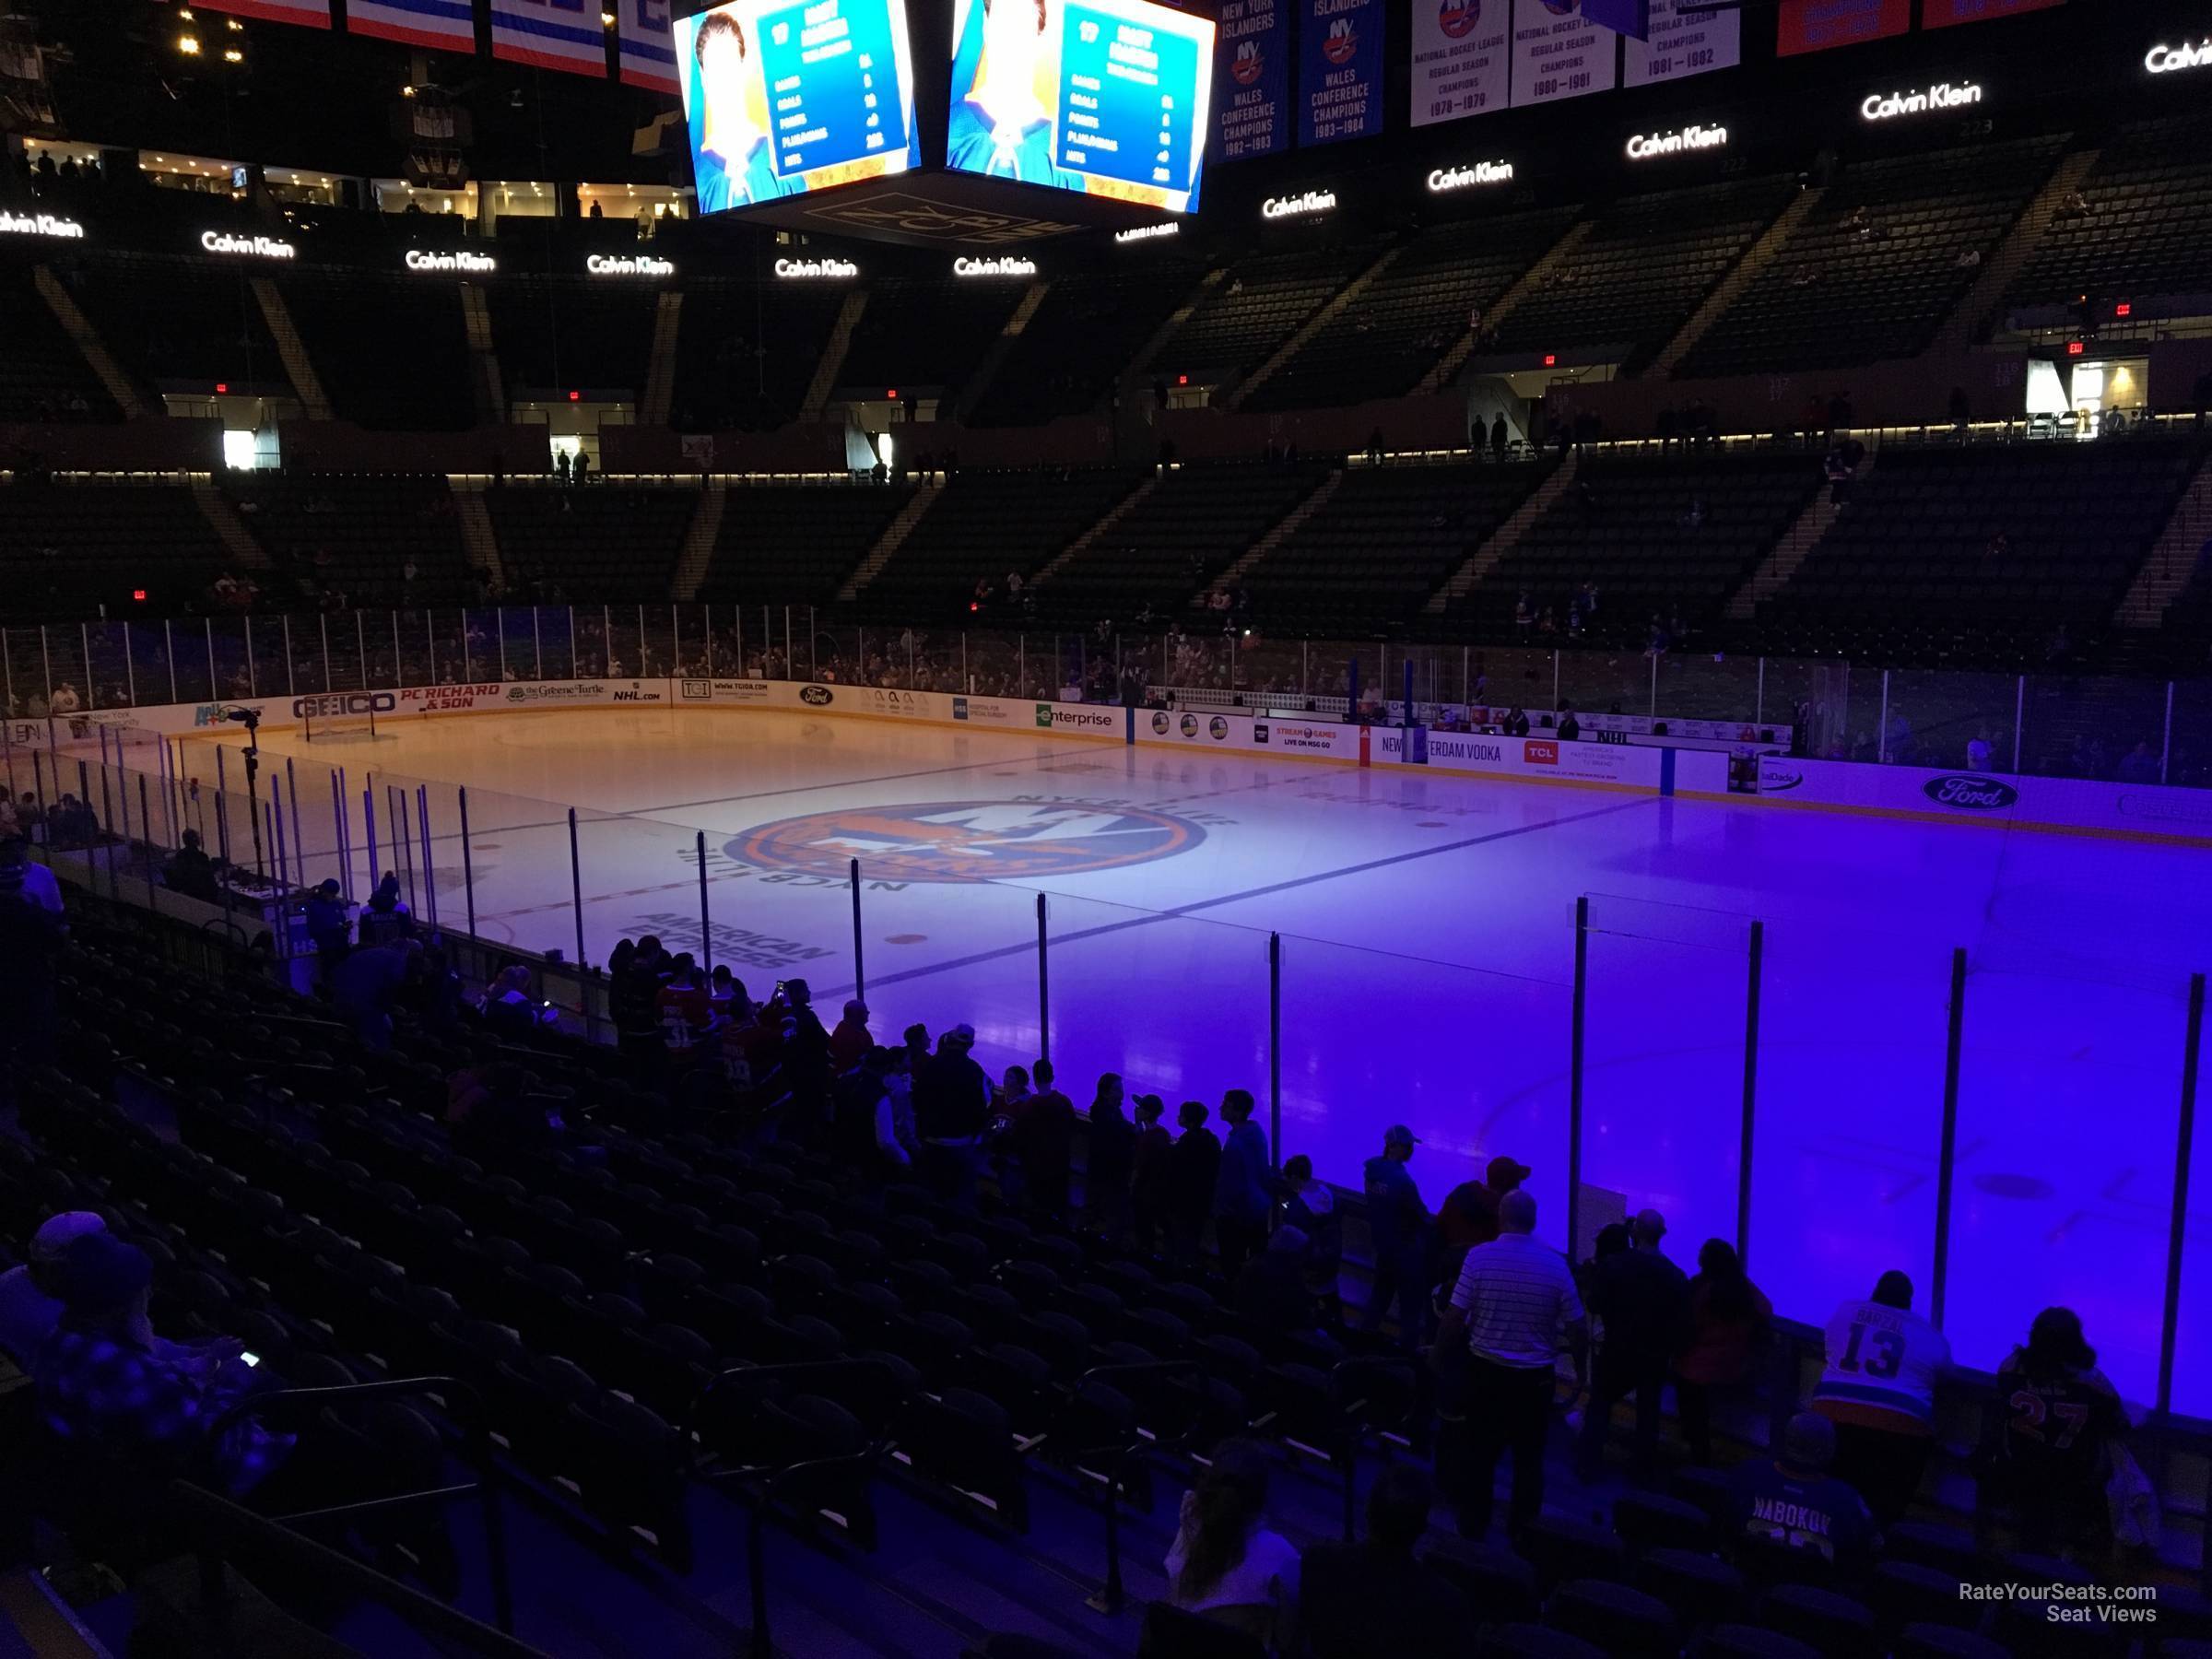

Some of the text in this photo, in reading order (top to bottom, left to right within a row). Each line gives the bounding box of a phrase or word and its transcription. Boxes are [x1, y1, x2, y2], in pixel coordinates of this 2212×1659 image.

[1222, 1, 1242, 20] NEW
[1222, 13, 1275, 39] ISLANDERS
[1516, 26, 1549, 41] NATIONAL
[1552, 18, 1581, 34] HOCKEY
[1415, 34, 1504, 64] NATIONAL HOCKEY LEAGUE
[1531, 35, 1594, 57] REGULAR SEASON
[1657, 31, 1705, 52] CHAMPIONS
[1429, 57, 1489, 79] REGULAR SEASON
[1541, 56, 1583, 73] CHAMPIONS
[1325, 68, 1356, 88] WALES
[1439, 77, 1479, 95] CHAMPIONS
[1234, 89, 1262, 106] WALES
[1312, 82, 1370, 107] CONFERENCE
[1862, 80, 1981, 119] Calvin Klein
[1221, 101, 1276, 125] CONFERENCE
[1313, 100, 1367, 123] CHAMPIONS
[1224, 119, 1273, 140] CHAMPIONS
[1628, 123, 1726, 158] Calvin Klein
[1429, 159, 1512, 190] Calvin Klein
[1263, 190, 1335, 218] Calvin Klein
[0, 211, 83, 238] alvin Klein
[202, 231, 294, 258] Calvin Klein
[406, 250, 495, 270] Calvin Klein
[587, 254, 673, 275] Calvin Klein
[775, 258, 857, 276] Calvin Klein
[954, 256, 1036, 275] Calvin Klein
[2069, 342, 2083, 354] EXIT
[425, 685, 500, 699] RICHARD
[539, 685, 574, 696] Greene
[575, 684, 605, 693] Turtle
[806, 688, 828, 703] Ford
[293, 693, 395, 718] GEICO
[427, 698, 474, 710] & SON
[1041, 711, 1112, 726] enterprise
[1277, 727, 1303, 736] STREAM
[1312, 729, 1336, 738] GAMES
[1382, 736, 1402, 752] NEW
[1467, 744, 1501, 761] VODKA
[1530, 747, 1553, 758] TCL
[1938, 779, 2003, 806] Ford
[633, 912, 838, 959] AMERICAN
[1839, 1321, 1905, 1380] 13
[2009, 1390, 2088, 1450] 27
